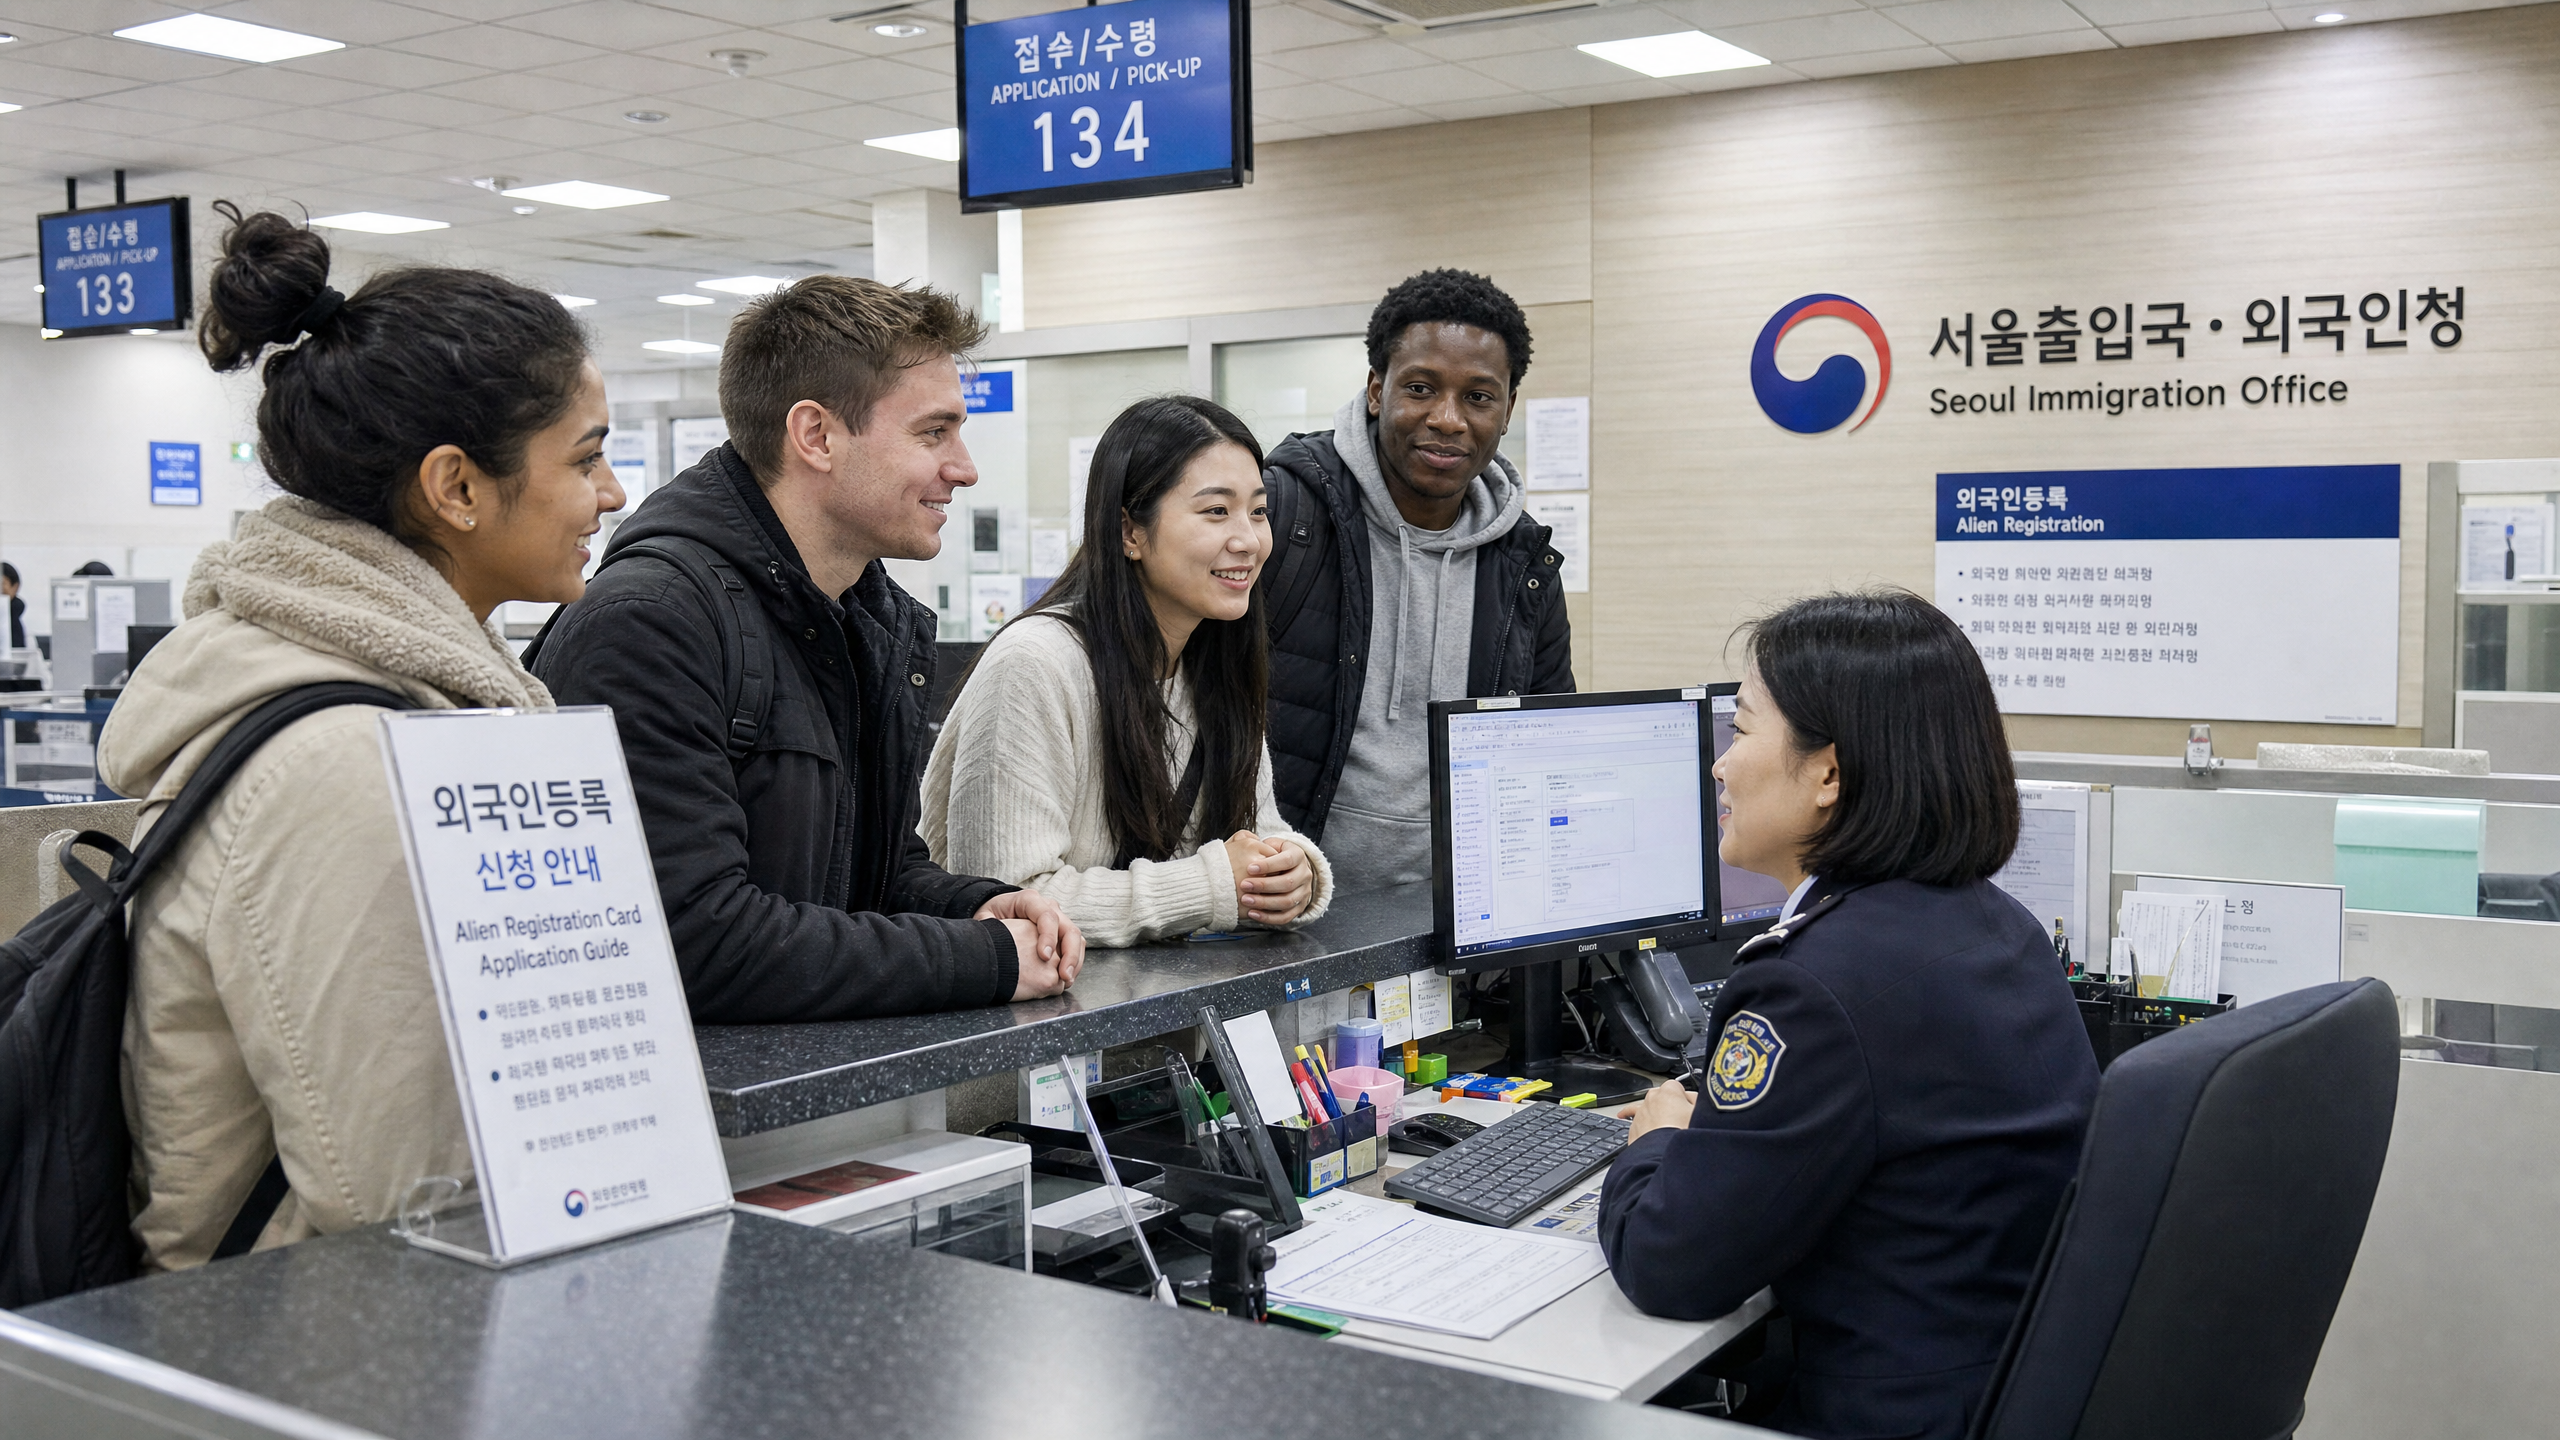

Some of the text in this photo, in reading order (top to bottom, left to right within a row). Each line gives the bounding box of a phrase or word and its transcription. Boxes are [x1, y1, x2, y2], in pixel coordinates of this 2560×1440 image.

[1014, 17, 1156, 74] 접수/수령
[990, 70, 1100, 105] APPLICATION
[1127, 56, 1202, 86] PICK-UP
[1033, 99, 1150, 172] 134
[76, 272, 135, 317] 133
[1929, 302, 2191, 368] 서울출입국
[2242, 286, 2464, 353] 외국인청
[1930, 374, 2348, 416] Seoul Immigration Office
[1955, 485, 2069, 513] 외국인등록
[1955, 514, 2105, 537] Alien Registration
[433, 779, 612, 833] 외국인등록
[476, 845, 602, 892] 신청 안내
[455, 903, 643, 943] Alien Registration Card
[479, 937, 630, 980] Application Guide
